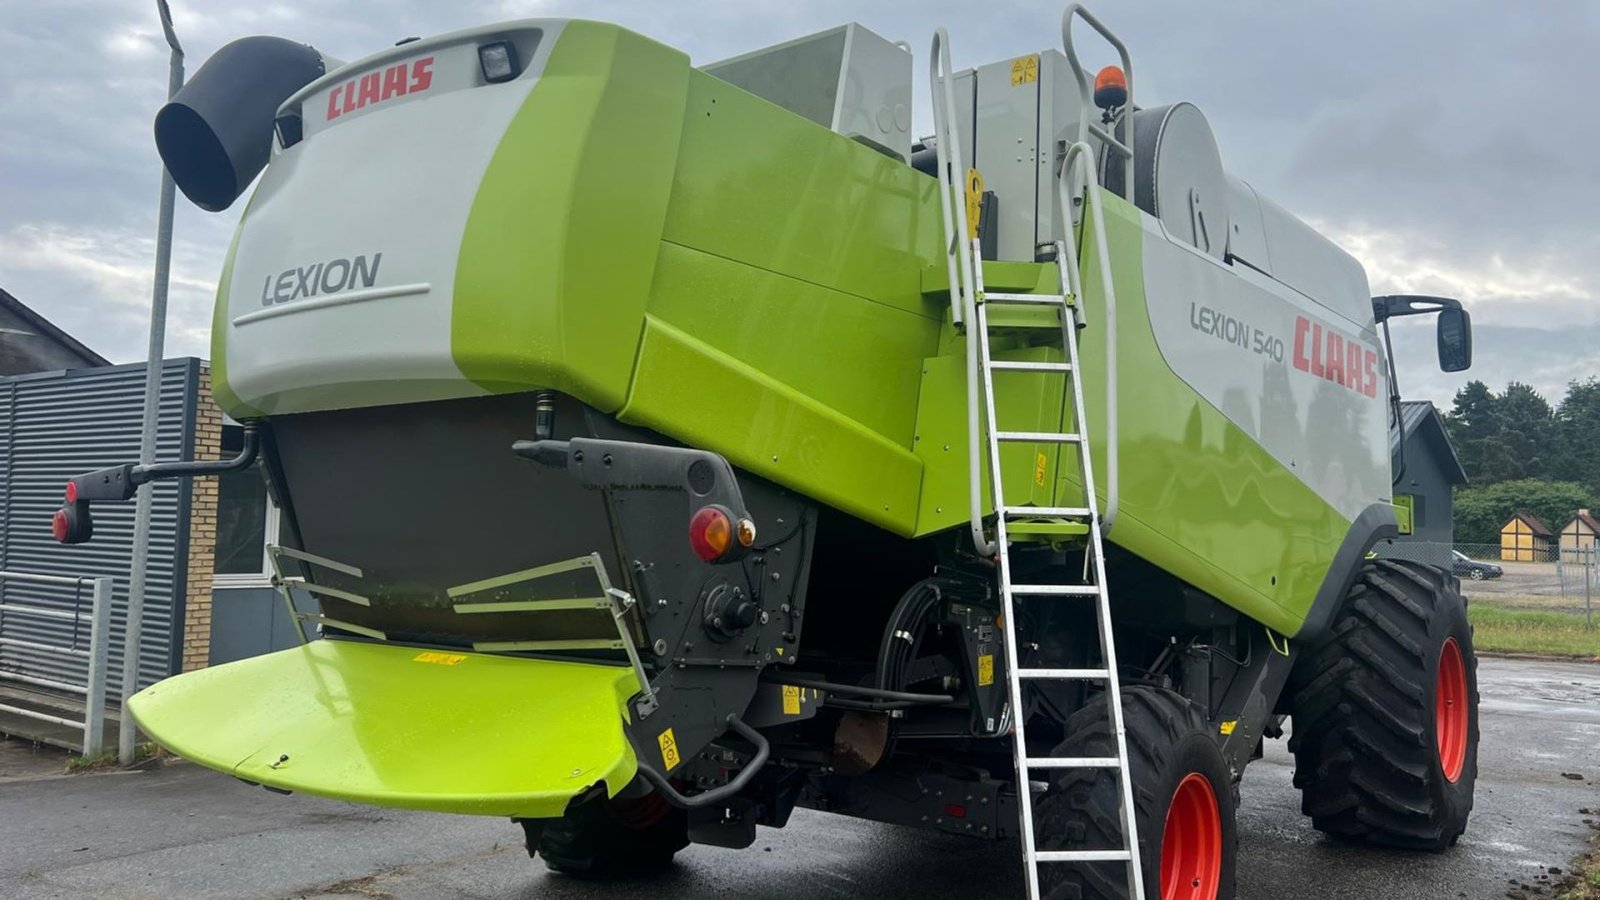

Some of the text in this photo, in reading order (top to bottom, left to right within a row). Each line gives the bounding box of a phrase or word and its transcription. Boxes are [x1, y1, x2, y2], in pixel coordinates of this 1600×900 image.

[326, 56, 434, 121] CLAAS
[262, 252, 382, 307] LEXION
[1190, 302, 1284, 363] LEXION 540
[1292, 315, 1377, 399] CLAAS
